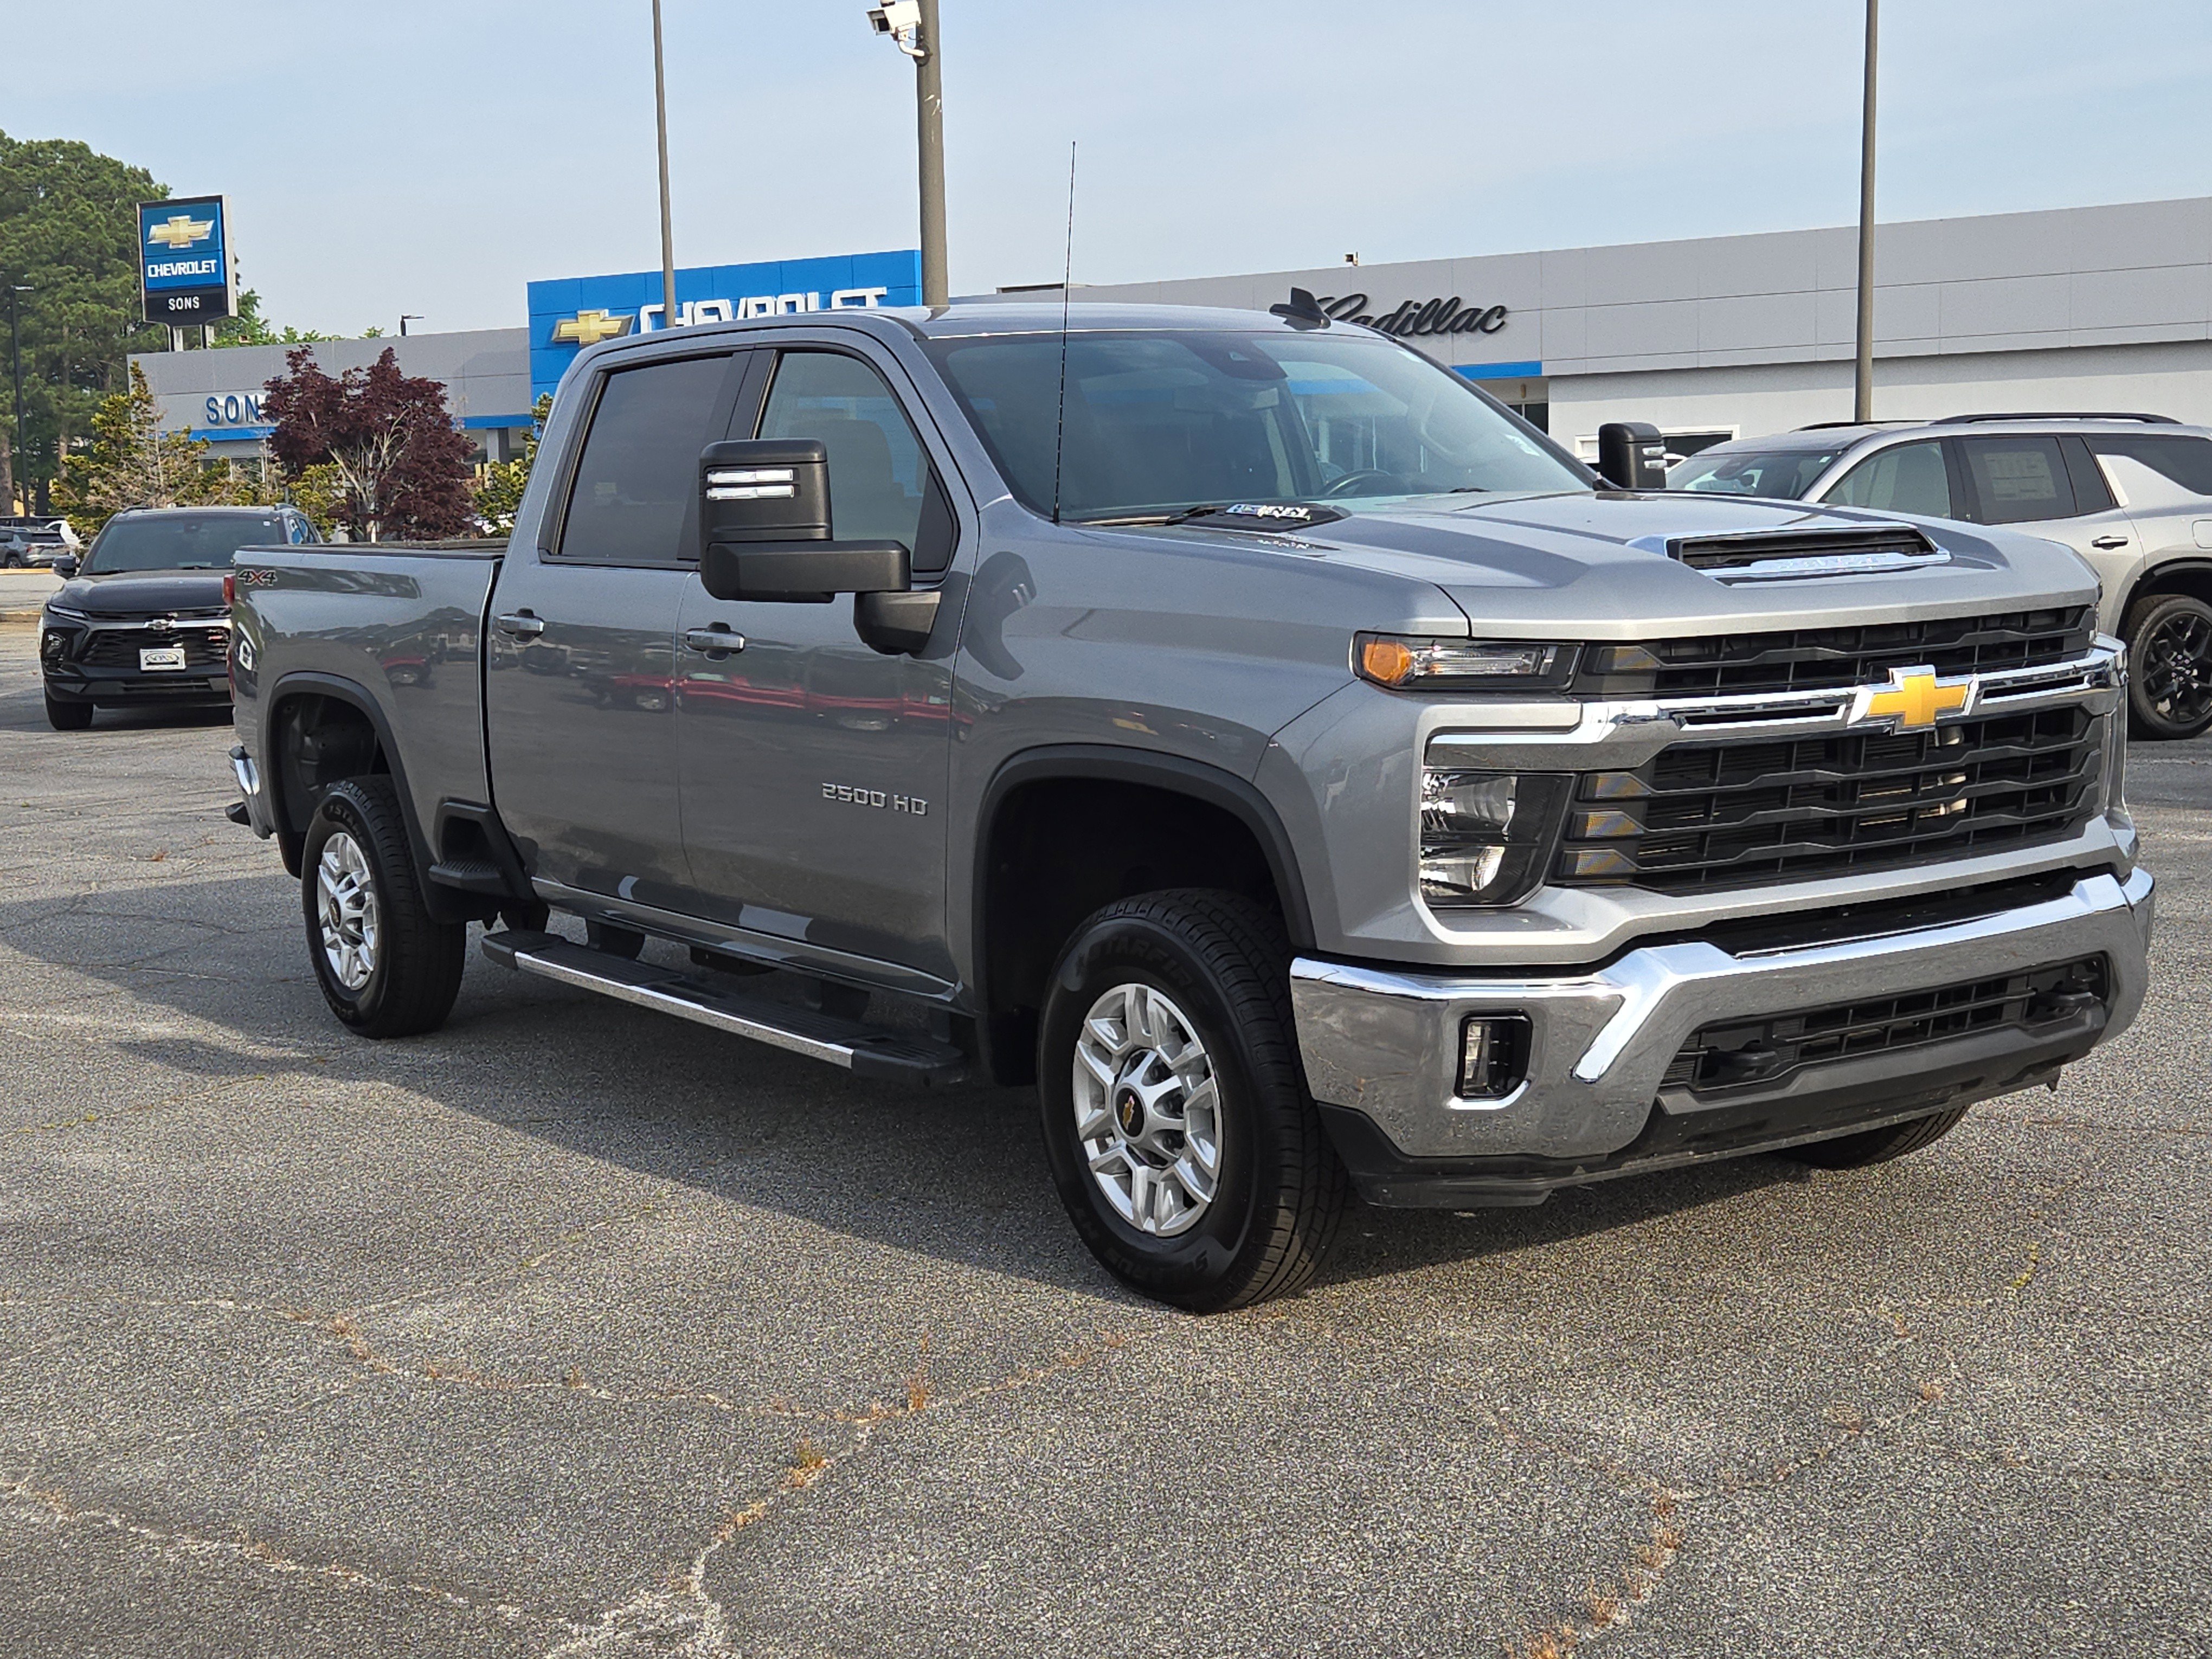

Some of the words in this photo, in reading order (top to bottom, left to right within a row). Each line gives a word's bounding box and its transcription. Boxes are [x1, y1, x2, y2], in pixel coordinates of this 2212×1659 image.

[148, 260, 217, 278] CHEVROLET
[168, 296, 200, 311] SONS
[206, 395, 262, 426] SON
[821, 782, 886, 808] 2500
[893, 794, 928, 815] HD
